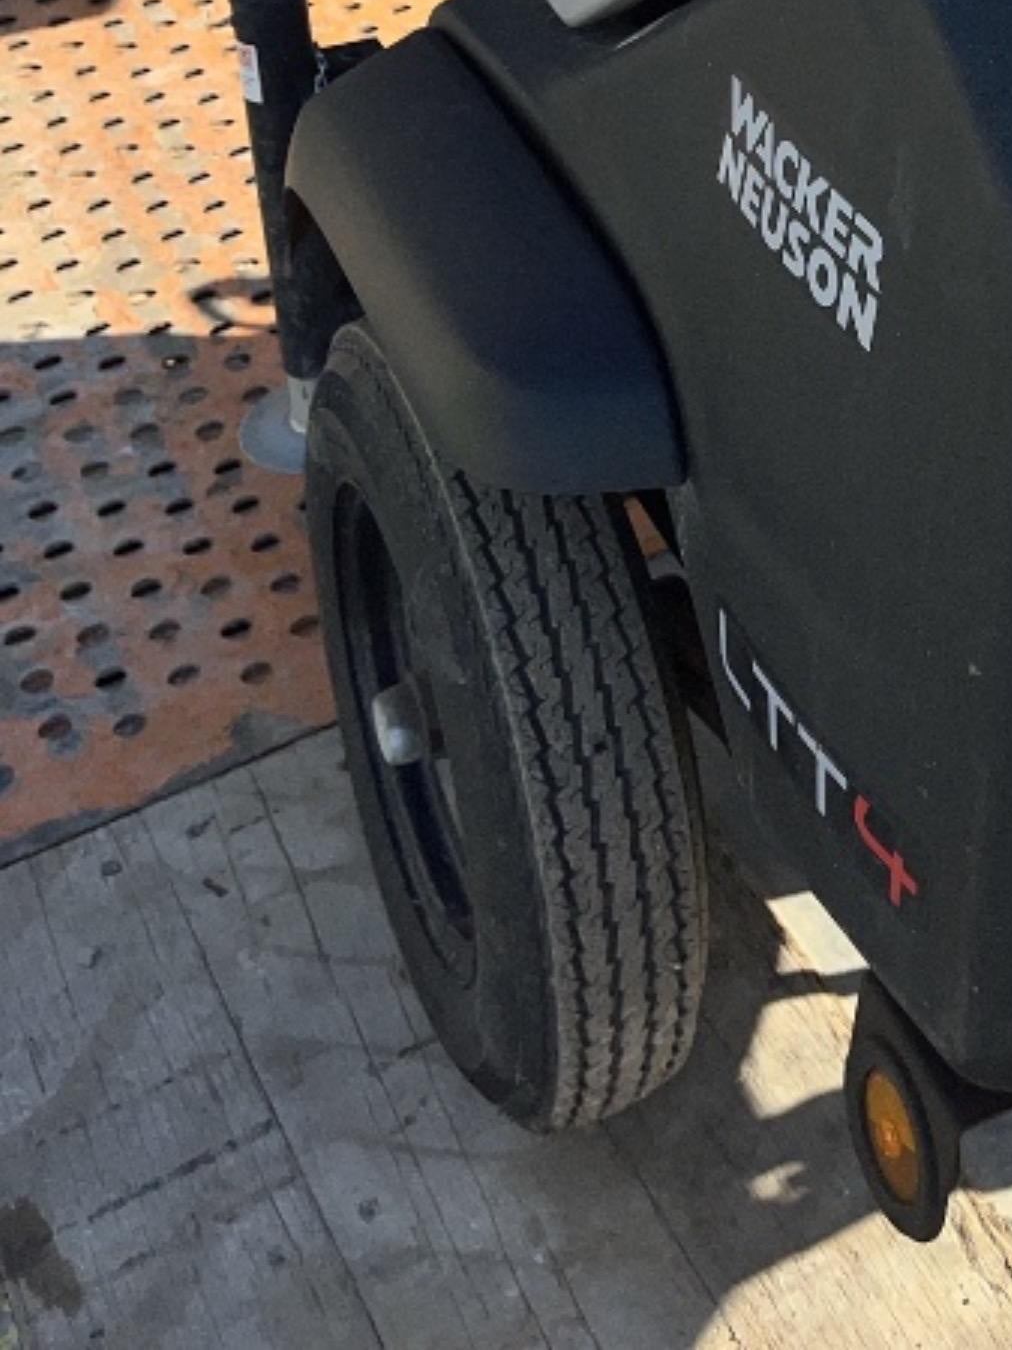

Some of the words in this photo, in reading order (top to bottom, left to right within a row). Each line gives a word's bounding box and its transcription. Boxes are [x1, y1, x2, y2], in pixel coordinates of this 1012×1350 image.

[717, 132, 877, 352] NEUSON
[731, 73, 883, 295] WACKER
[719, 607, 919, 907] LTT4
